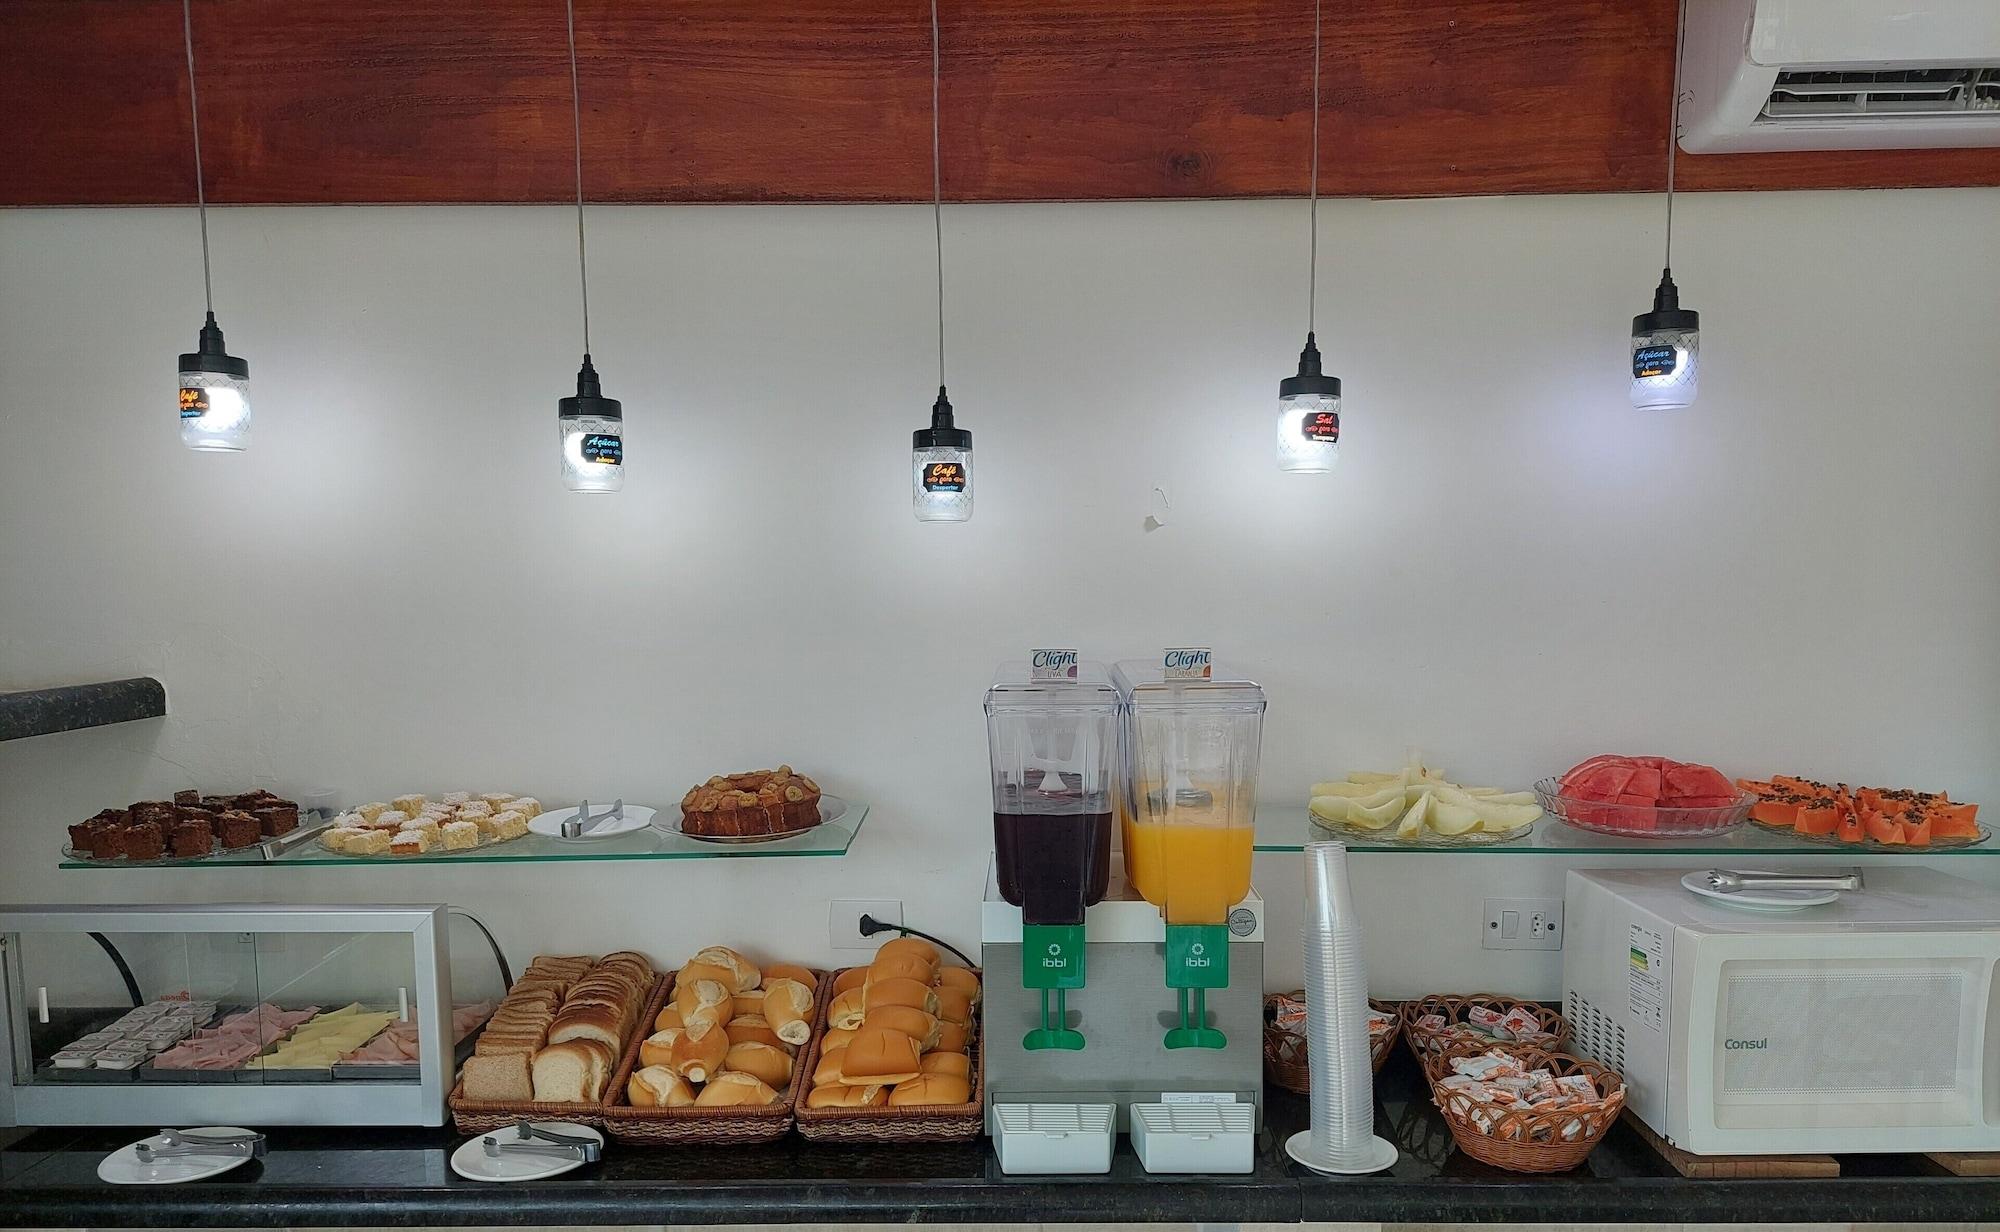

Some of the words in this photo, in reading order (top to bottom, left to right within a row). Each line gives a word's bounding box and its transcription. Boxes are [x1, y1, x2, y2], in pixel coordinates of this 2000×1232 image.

[587, 436, 619, 447] Açúcar
[933, 464, 957, 476] Café
[1033, 651, 1077, 670] Clight
[1165, 650, 1211, 670] Clight
[1042, 957, 1067, 968] ibbl
[1185, 957, 1210, 967] ibbl
[1725, 1038, 1767, 1049] Consul
